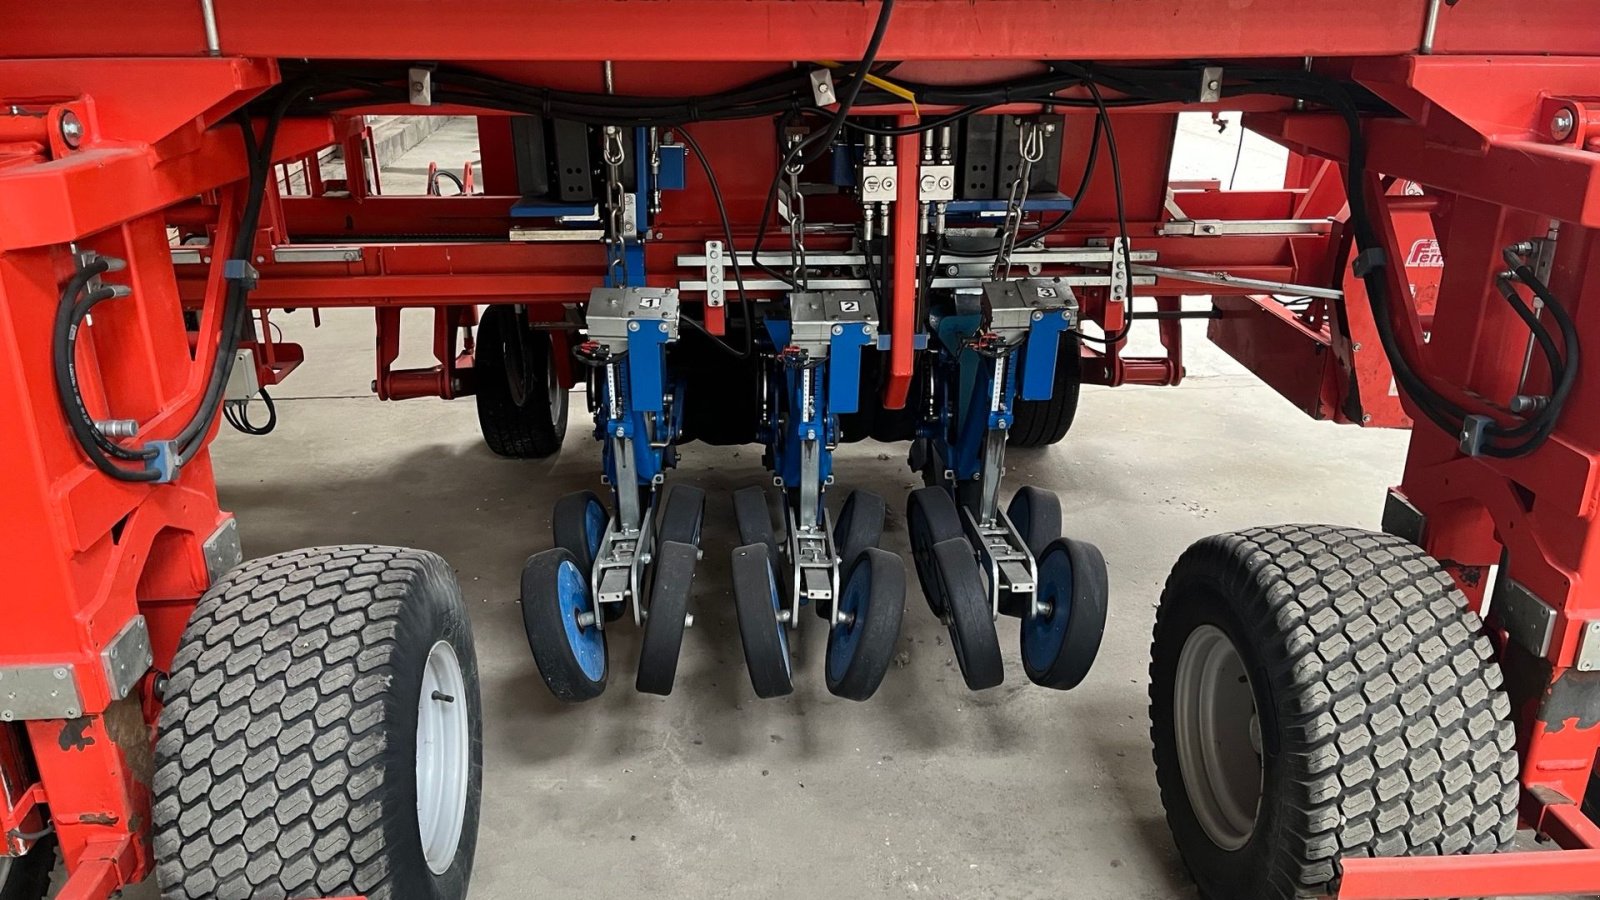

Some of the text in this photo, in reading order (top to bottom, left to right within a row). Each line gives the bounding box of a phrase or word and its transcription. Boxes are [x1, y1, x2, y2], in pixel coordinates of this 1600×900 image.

[1040, 288, 1053, 297] 3
[645, 299, 653, 308] 1
[844, 302, 855, 311] 2
